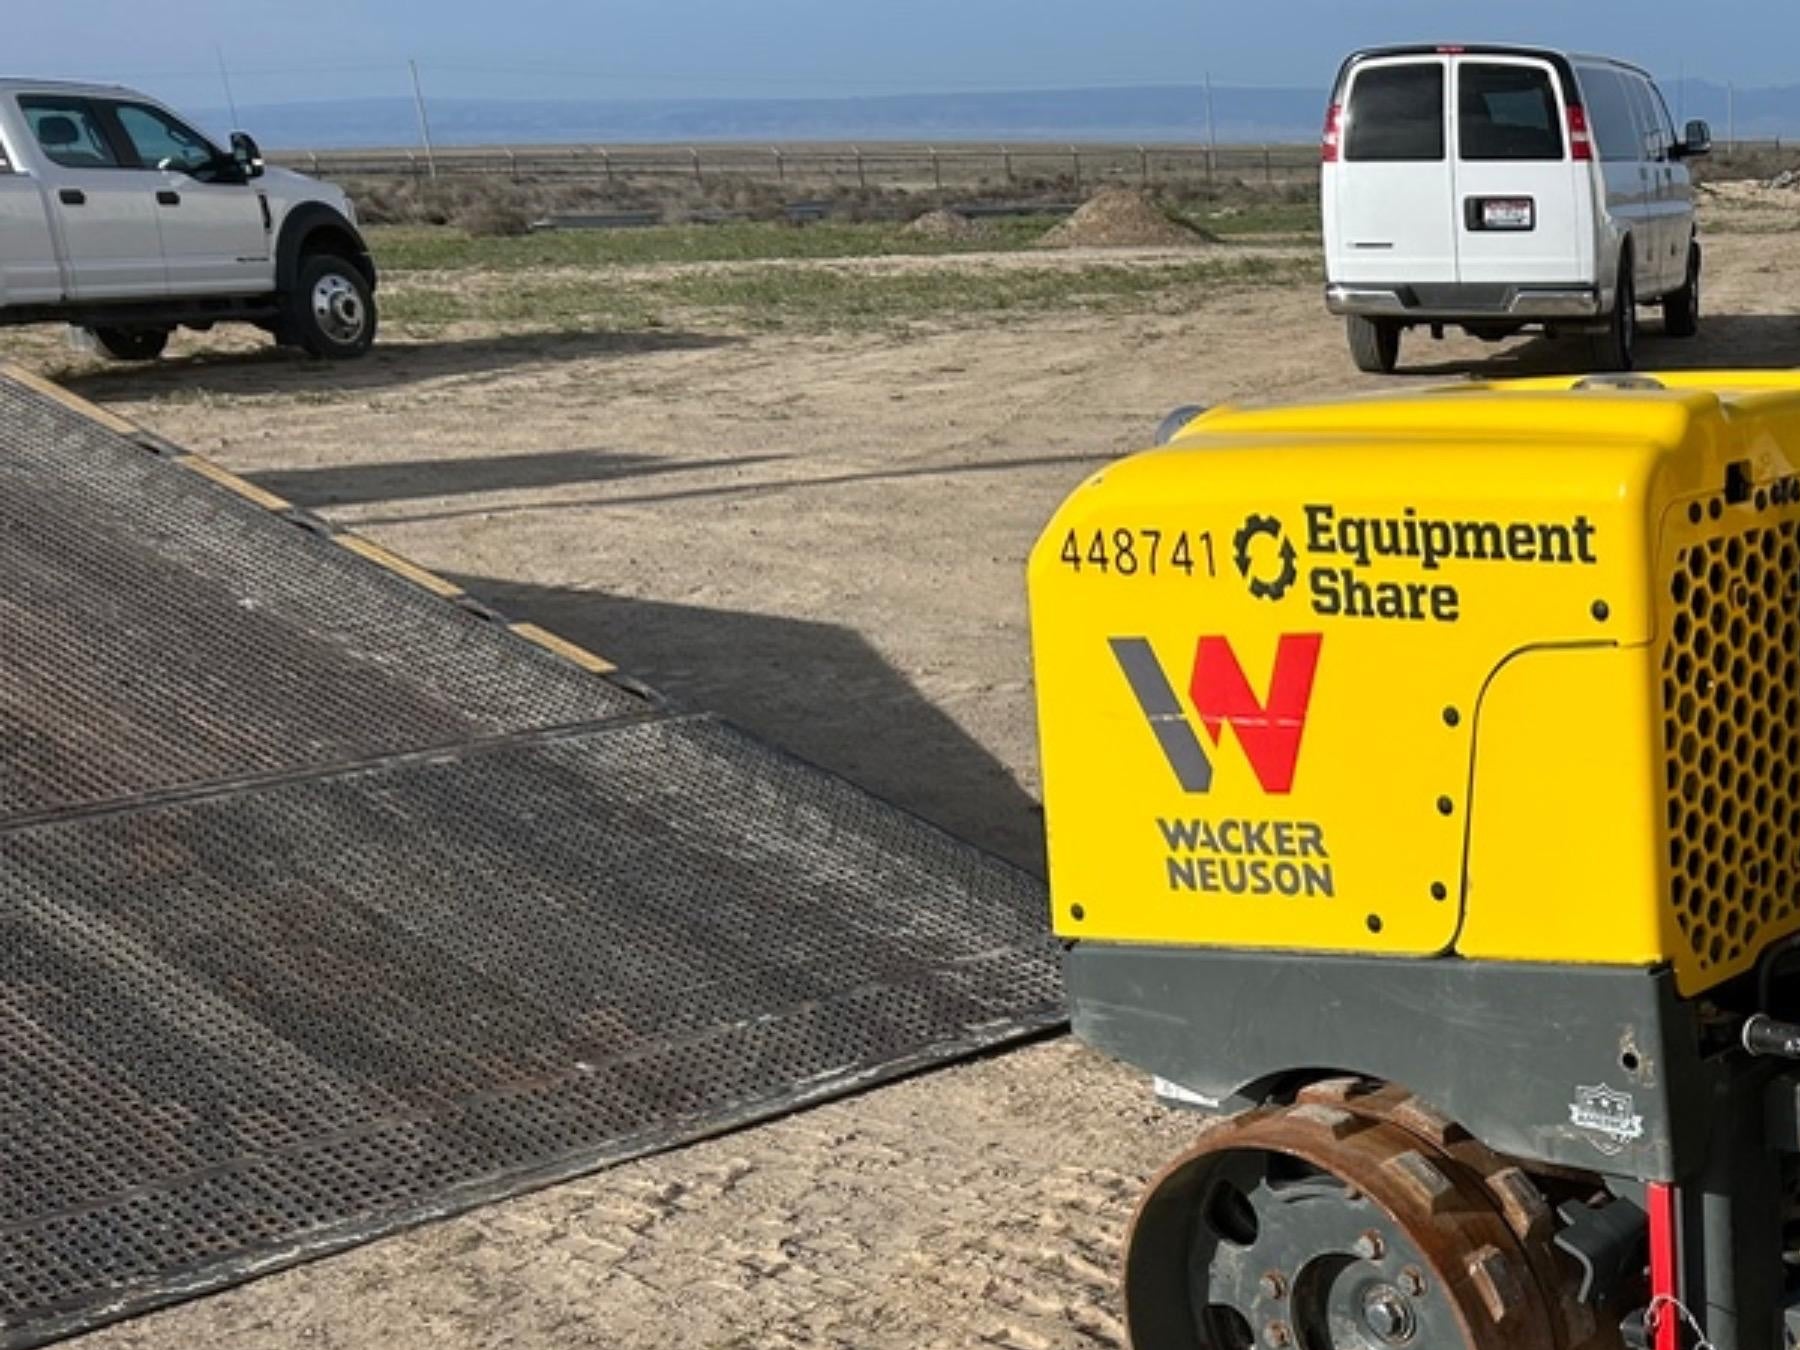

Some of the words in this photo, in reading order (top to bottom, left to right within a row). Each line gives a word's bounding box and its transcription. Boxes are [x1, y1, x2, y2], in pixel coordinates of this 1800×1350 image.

[1060, 527, 1216, 577] 448741
[1303, 504, 1597, 569] Equipment
[1309, 566, 1459, 622] Share
[1156, 817, 1329, 858] WACKER
[1166, 857, 1335, 897] NEUSON
